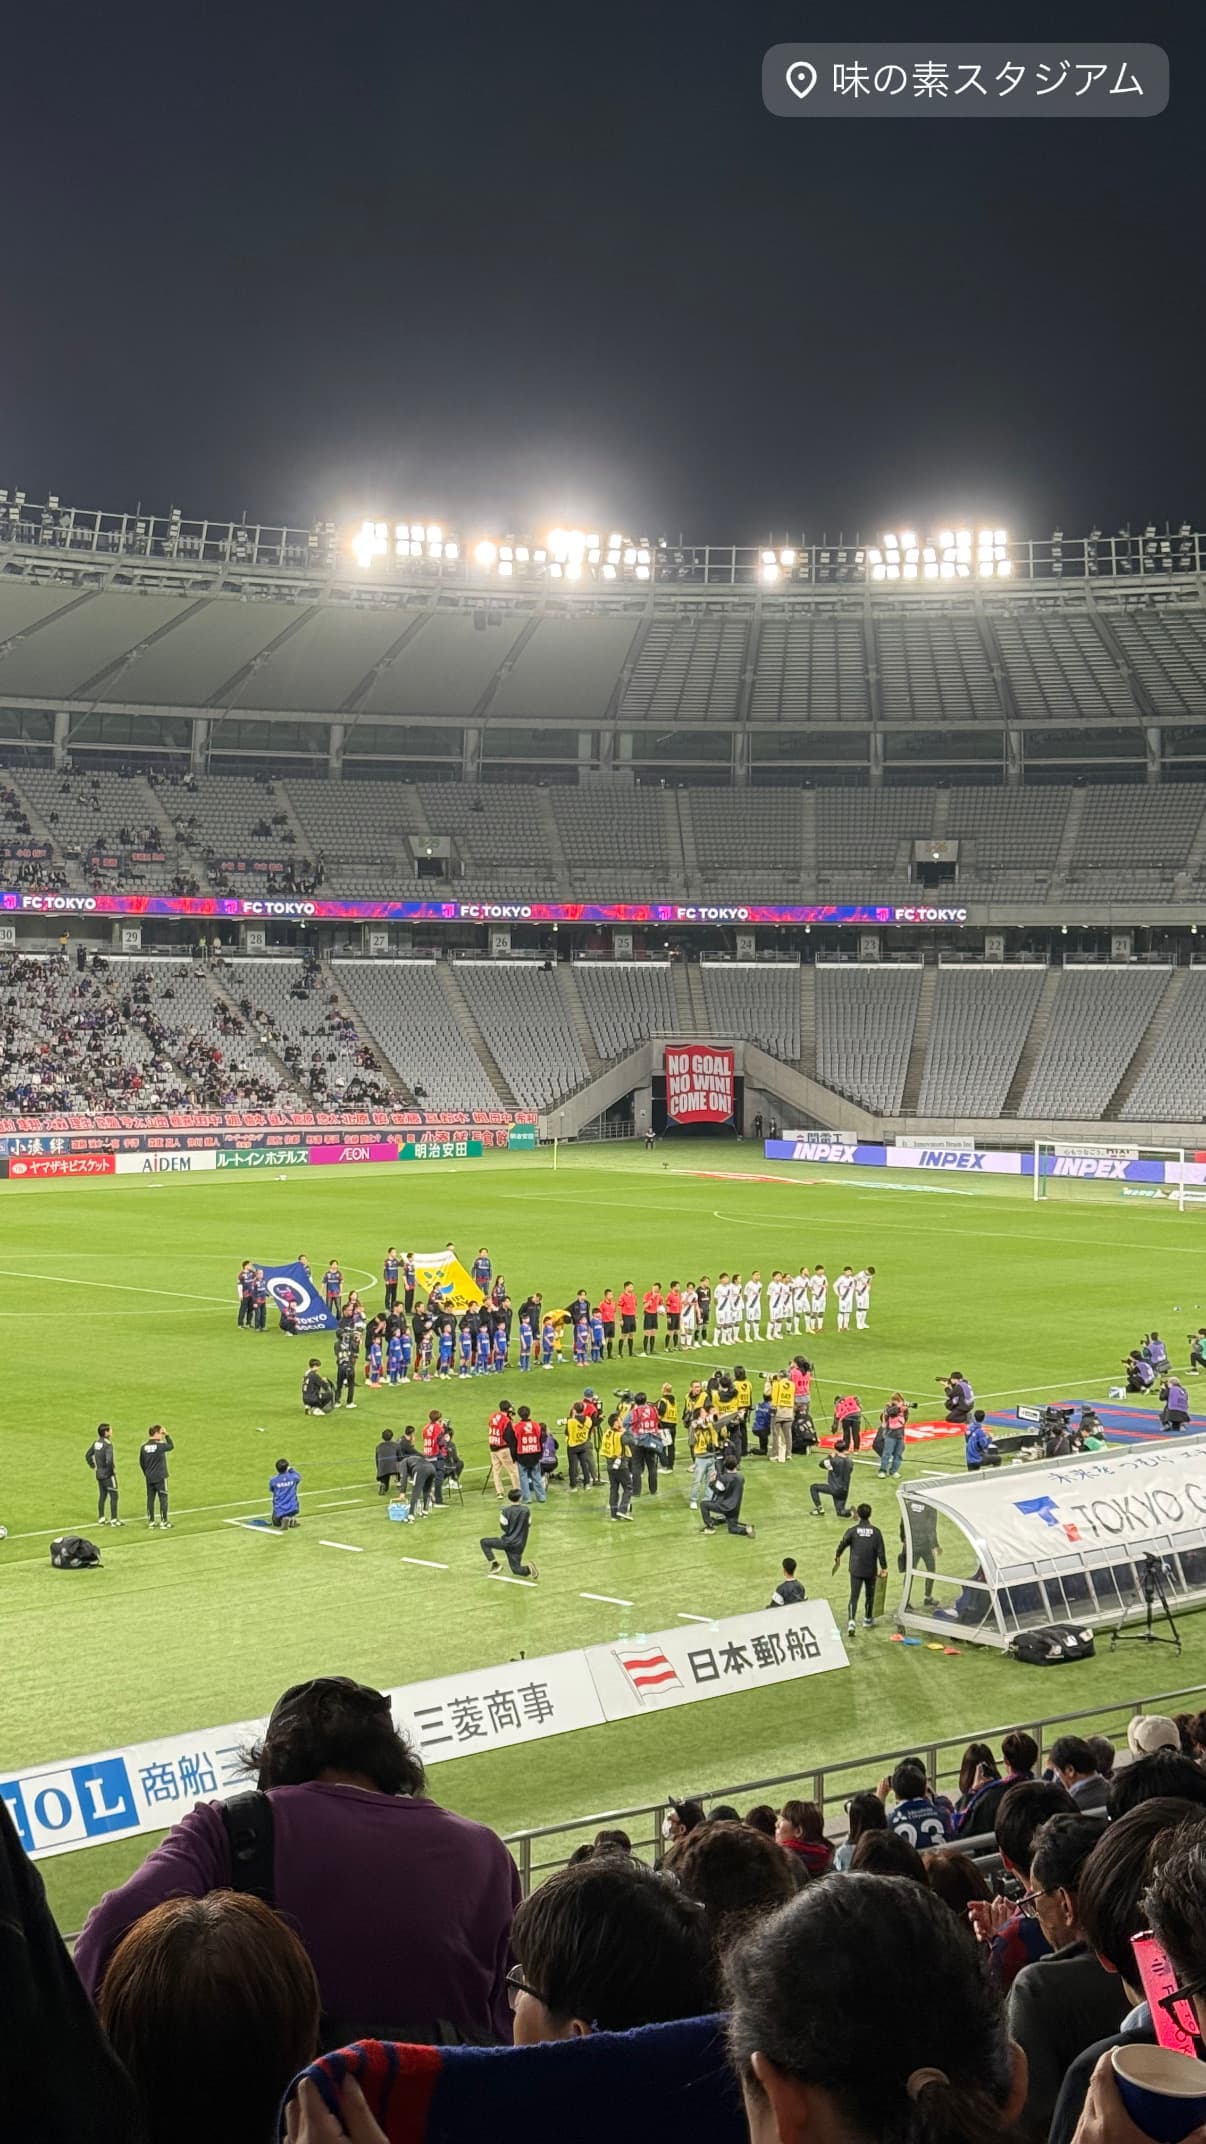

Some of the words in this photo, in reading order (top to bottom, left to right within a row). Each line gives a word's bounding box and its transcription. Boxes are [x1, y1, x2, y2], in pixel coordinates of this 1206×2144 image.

[23, 896, 42, 908] FC
[46, 897, 96, 909] TOKYO
[243, 901, 263, 913] FC
[265, 902, 315, 914] TOKYO
[461, 906, 480, 916] FC
[482, 906, 531, 917] TOKYO
[677, 908, 697, 919] FC
[699, 908, 749, 919] TOKYO
[895, 909, 915, 920] FC
[125, 932, 138, 942] 29
[250, 934, 263, 945] 28
[373, 936, 385, 946] 27
[495, 937, 508, 948] 26
[617, 938, 630, 948] 25
[864, 939, 876, 949] 23
[989, 940, 1001, 950] 22
[668, 1054, 690, 1075] NO
[692, 1055, 731, 1076] GOAL
[669, 1074, 691, 1096] NO
[692, 1074, 731, 1094] WIN!
[670, 1092, 708, 1116] COME
[709, 1092, 732, 1114] ON!
[415, 1142, 468, 1158] 明治安田
[793, 1143, 857, 1163] INPEX
[30, 1158, 110, 1174] ヤマザキビスケット
[217, 1151, 309, 1167] ルートインホテルズ
[919, 1151, 986, 1170] INPEX
[1053, 1158, 1130, 1179] INPEX
[1071, 1489, 1184, 1538] TOKYO
[687, 1626, 822, 1683] 日本郵船
[413, 1681, 555, 1747] 三菱商事
[138, 1745, 259, 1807] 商船三
